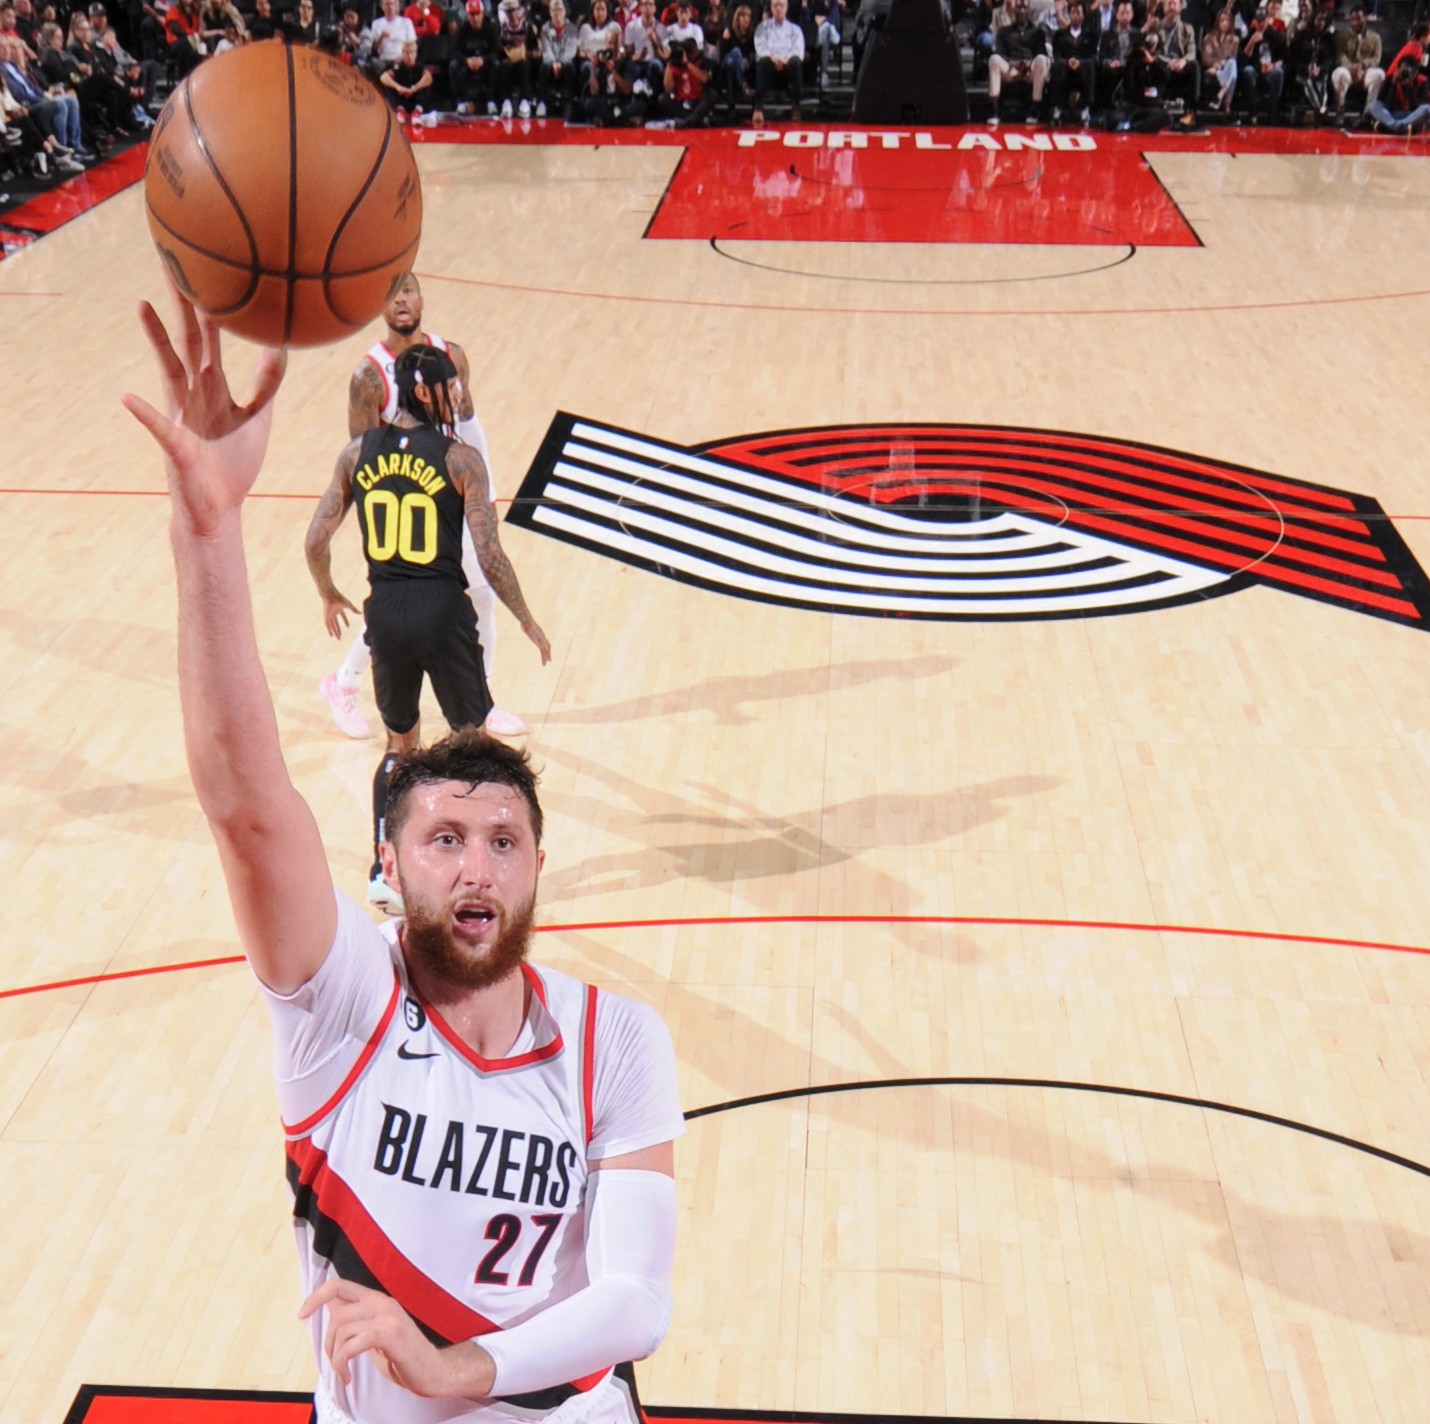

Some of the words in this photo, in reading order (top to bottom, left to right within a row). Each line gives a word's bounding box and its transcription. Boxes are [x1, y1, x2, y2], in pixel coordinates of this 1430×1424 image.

[734, 130, 1098, 151] PORTLAND
[356, 453, 447, 497] CLARKSON
[364, 489, 438, 565] 00
[403, 1001, 420, 1030] 6
[373, 1100, 577, 1209] BLAZERS
[474, 1212, 564, 1287] 27
